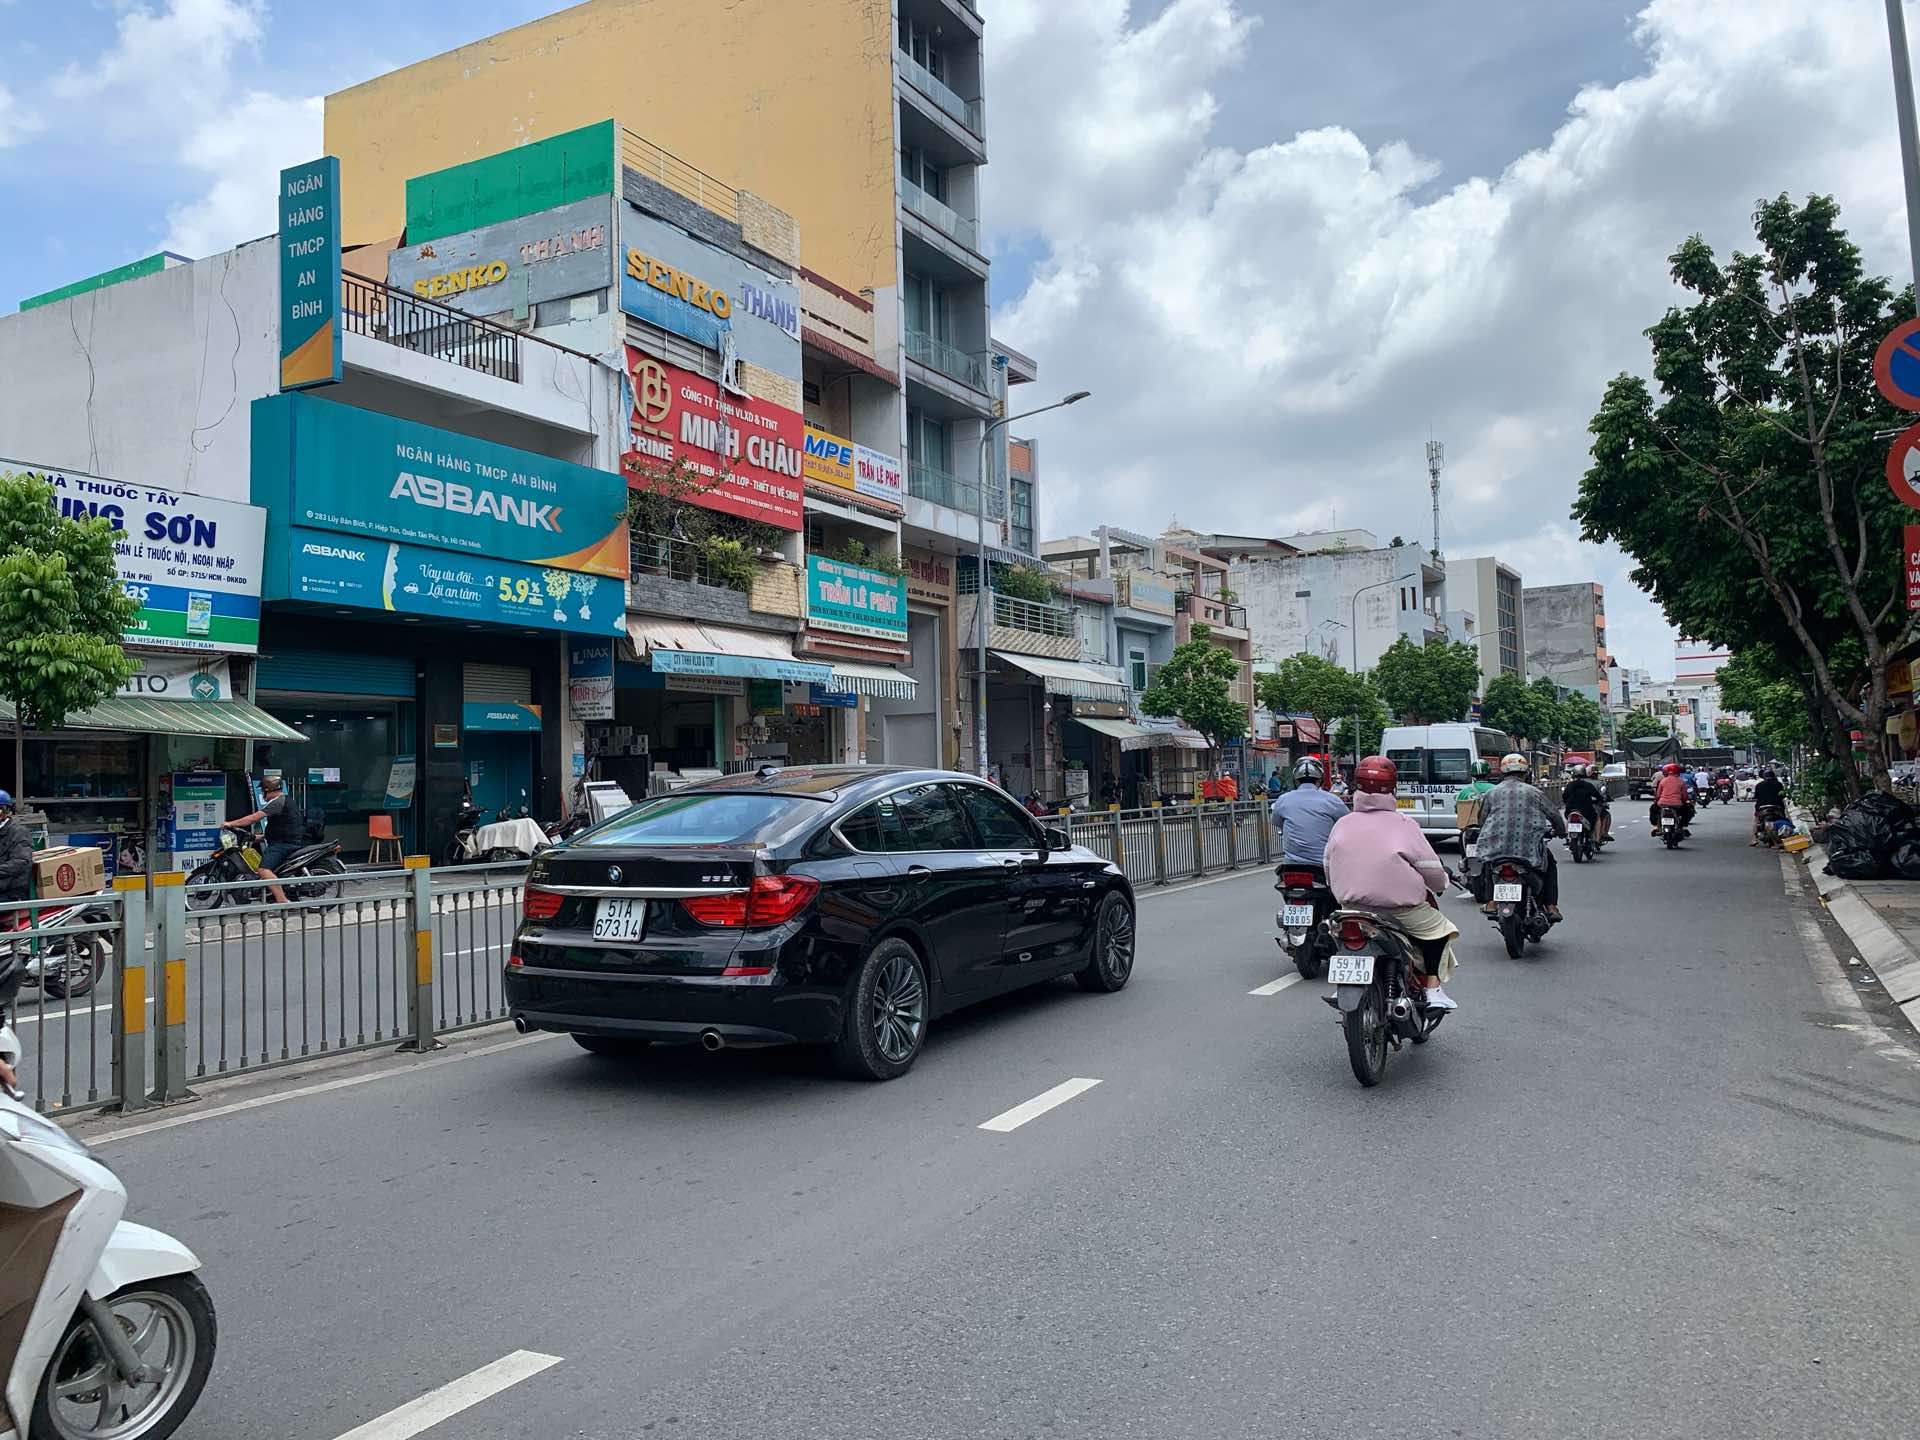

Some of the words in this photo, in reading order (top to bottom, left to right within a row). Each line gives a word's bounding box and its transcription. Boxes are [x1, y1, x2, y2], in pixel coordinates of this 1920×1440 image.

[287, 173, 323, 198] NGÂN
[288, 204, 324, 227] HÀNG
[288, 236, 325, 258] TMCP
[297, 269, 316, 288] AN
[413, 259, 508, 299] SENKO
[627, 248, 732, 319] SENKO
[291, 299, 323, 321] BÌNH
[681, 385, 702, 404] CÔNG
[703, 395, 714, 408] TY
[735, 405, 753, 424] VLXD
[760, 417, 778, 431] TTNT
[630, 434, 674, 462] PRIME
[680, 411, 740, 458] MINH
[747, 438, 801, 479] CHÂU
[804, 434, 852, 466] MPE
[396, 444, 433, 464] NGÂN
[437, 453, 471, 473] HÀNG
[475, 463, 508, 481] TMCP
[511, 472, 527, 486] AN
[530, 475, 558, 493] BÌNH
[700, 464, 715, 477] MEN
[76, 479, 138, 500] THUỐC
[145, 491, 180, 506] TÂY
[389, 471, 554, 532] ABBANK
[314, 513, 327, 521] 283
[144, 511, 217, 549] SƠN
[134, 541, 144, 558] LẺ
[147, 546, 171, 562] THUỐC
[192, 553, 214, 569] NGOẠI
[216, 556, 235, 570] NHẬP
[302, 543, 362, 561] ABBANK
[122, 571, 136, 580] TÂN
[419, 564, 442, 583] Vay
[444, 588, 459, 598] an
[498, 576, 529, 603] 5.9
[852, 584, 867, 609] LÊ
[138, 636, 180, 647] HISAMITSU
[198, 641, 215, 649] NAM
[608, 900, 632, 918] 51A
[595, 919, 638, 939] 673.14
[1336, 958, 1366, 970] 59-N1
[1331, 970, 1370, 983] 157.50
